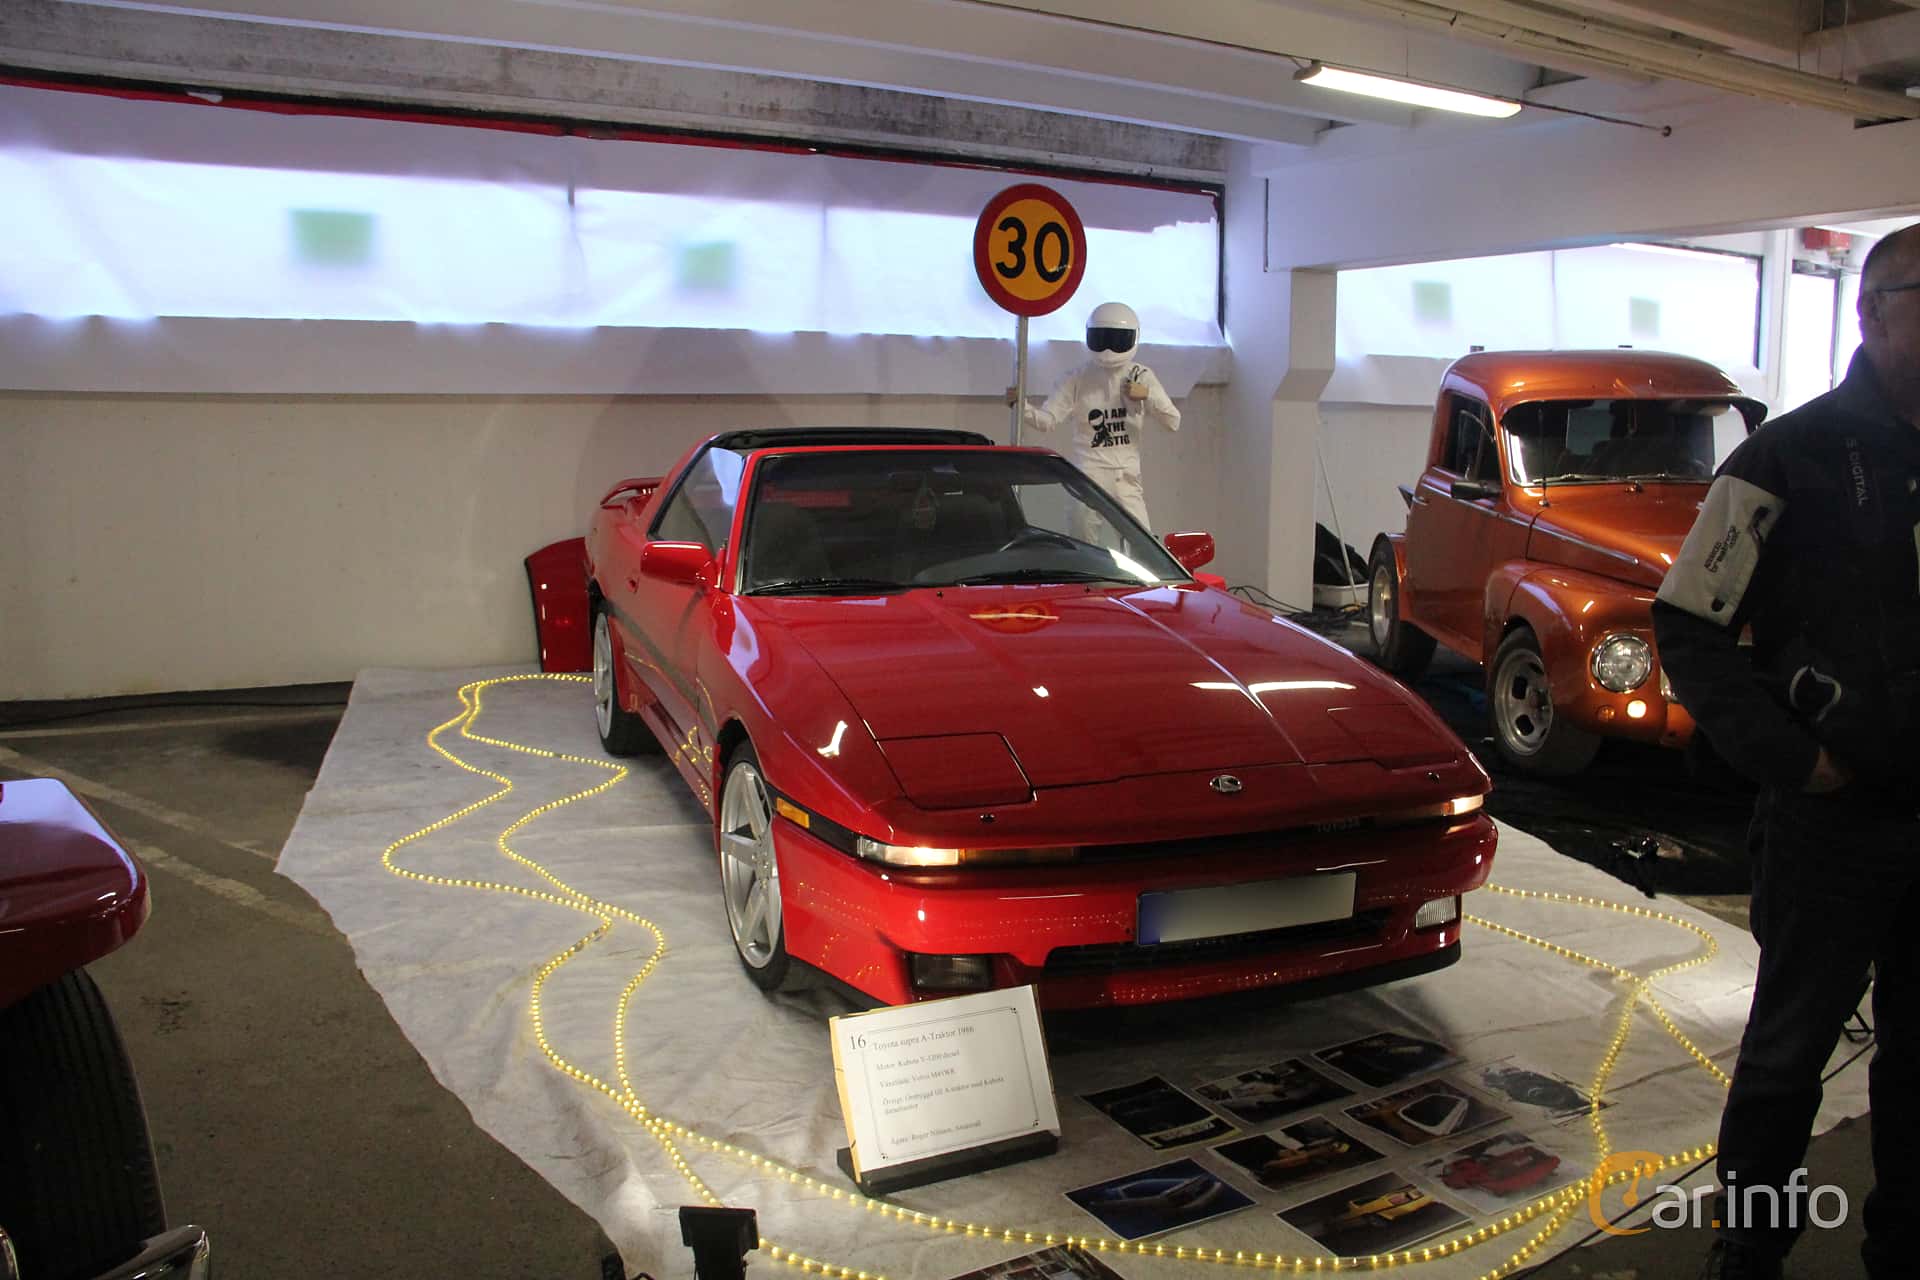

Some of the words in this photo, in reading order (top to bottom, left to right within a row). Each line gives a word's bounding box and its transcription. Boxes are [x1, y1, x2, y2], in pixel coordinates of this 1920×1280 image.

[996, 216, 1070, 283] 30
[1104, 409, 1109, 419] I
[1111, 407, 1127, 419] AM
[1106, 421, 1126, 432] THE
[1107, 434, 1131, 447] STIG
[849, 1033, 866, 1050] 16
[874, 1040, 899, 1051] Toyota
